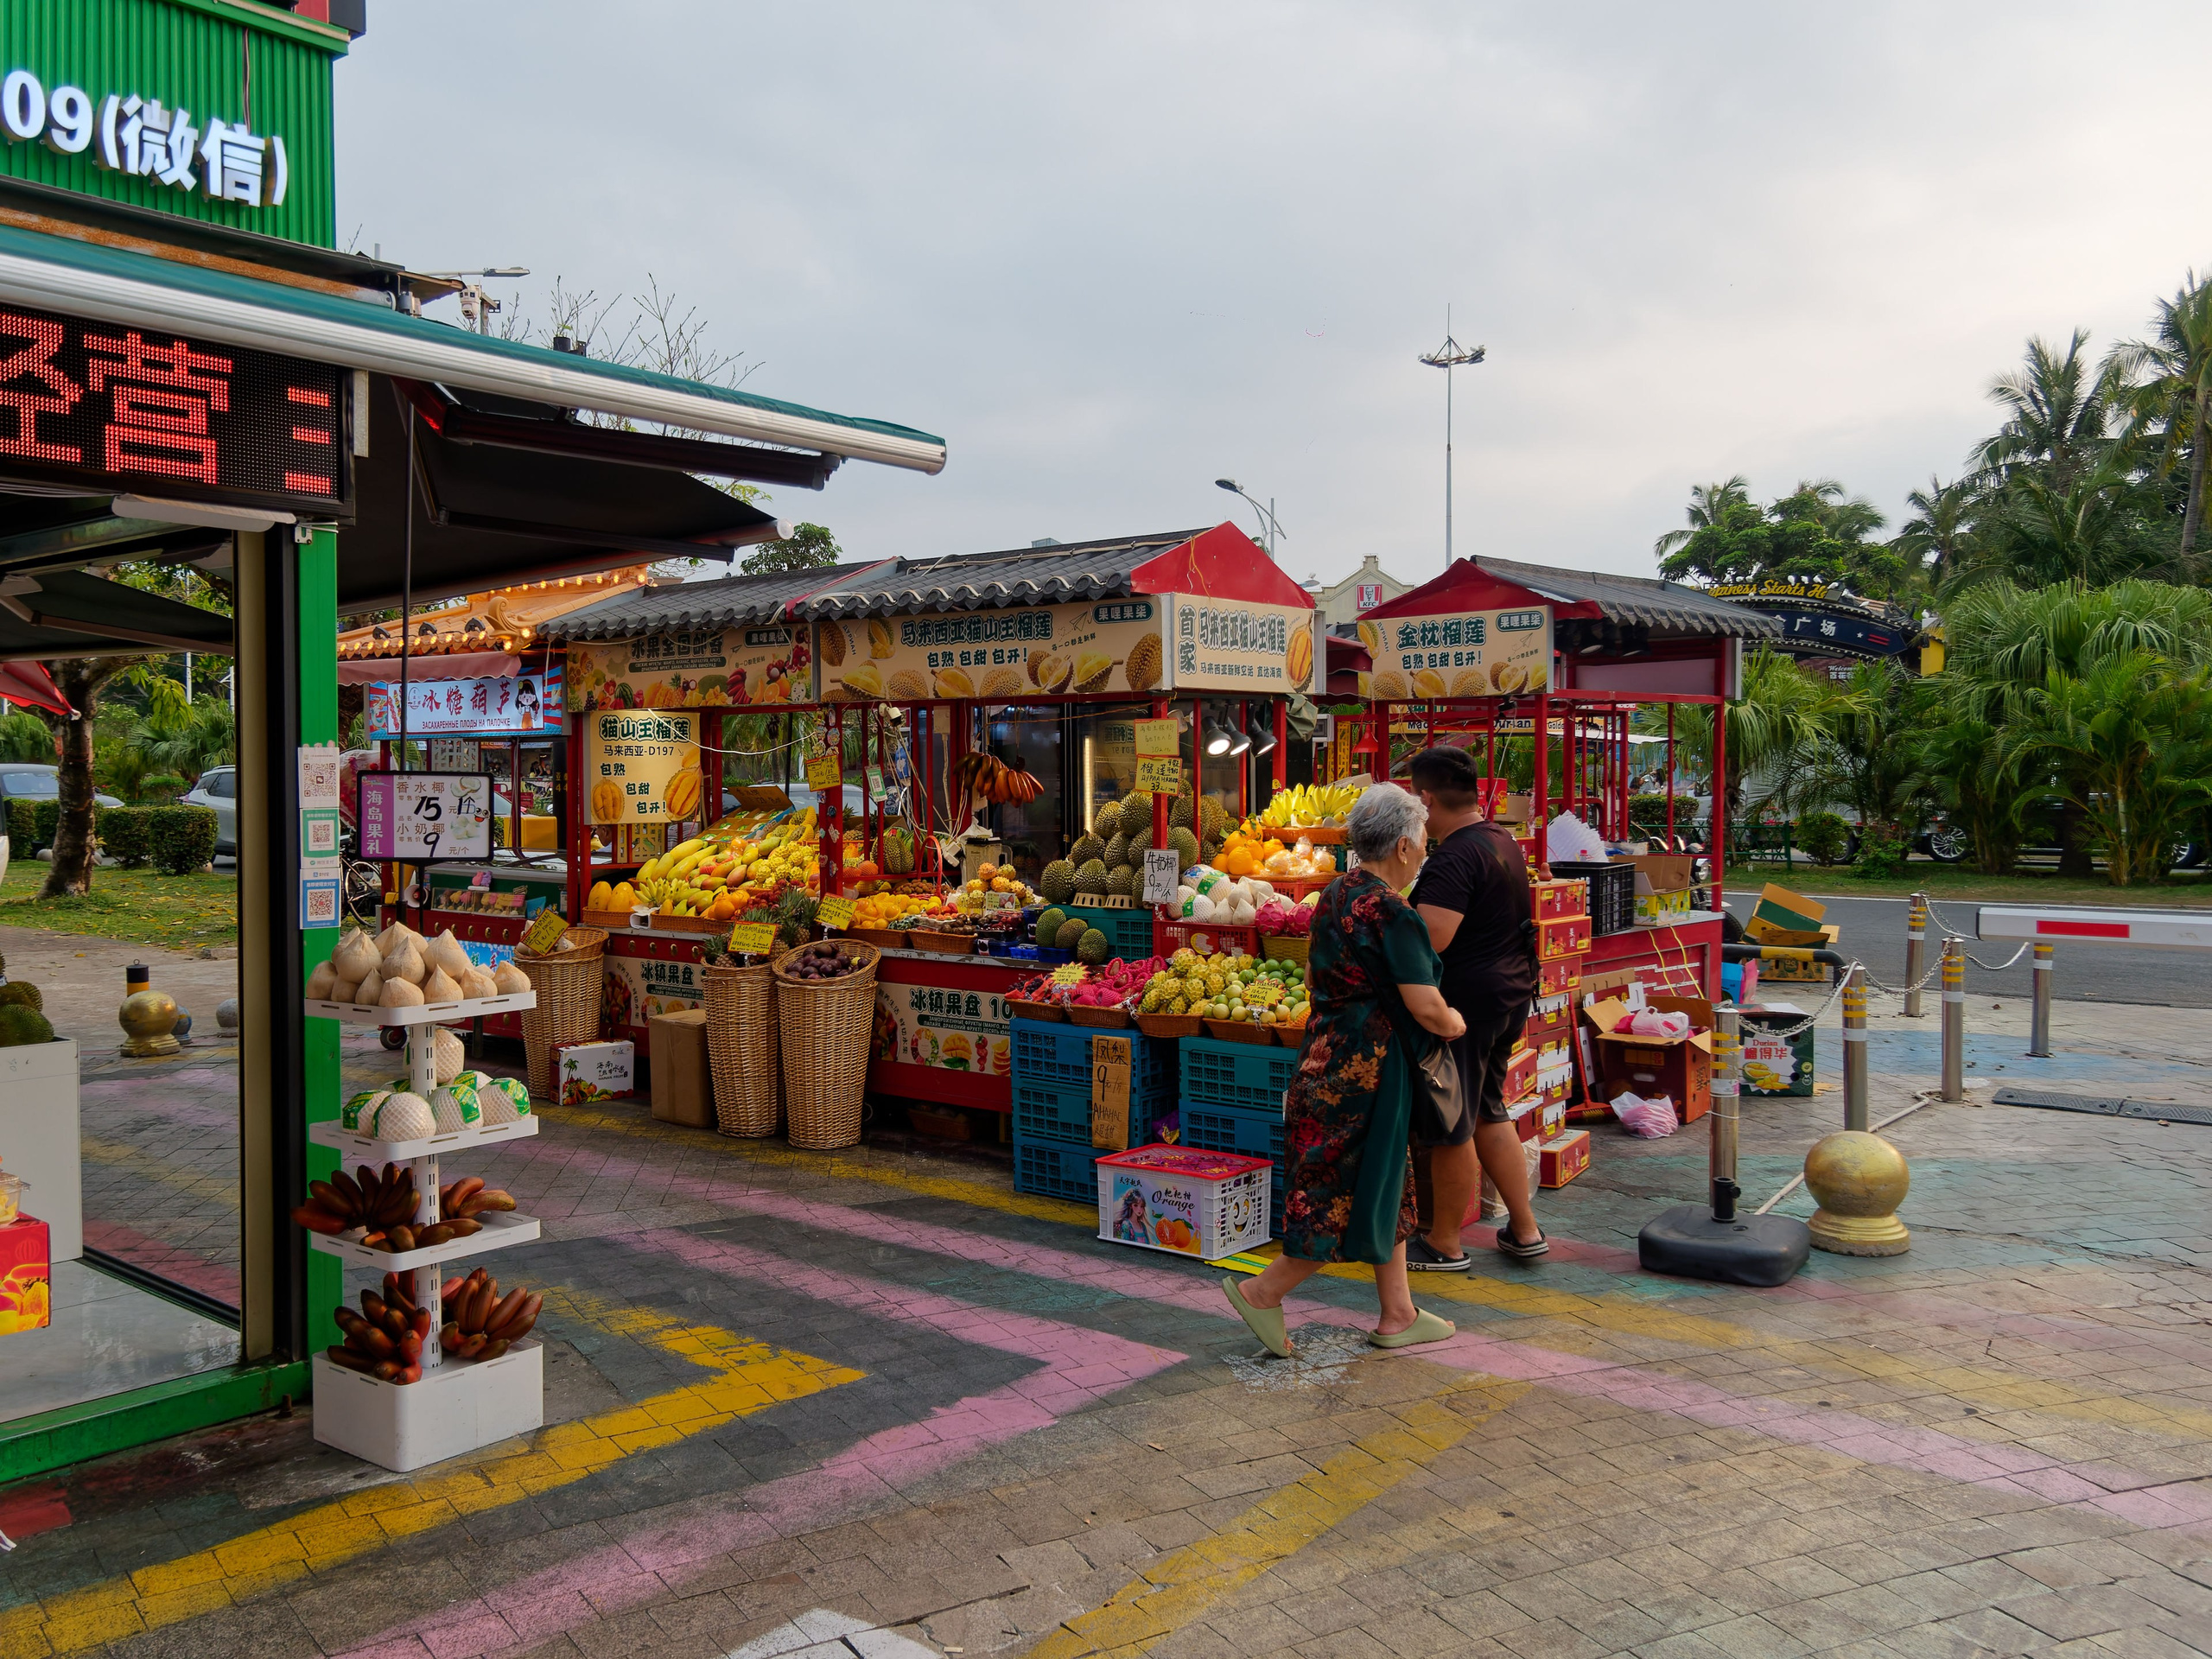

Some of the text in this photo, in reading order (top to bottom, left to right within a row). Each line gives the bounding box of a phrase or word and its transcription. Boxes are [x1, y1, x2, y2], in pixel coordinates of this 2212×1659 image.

[3, 70, 288, 207] 09(微信)
[1759, 579, 1805, 596] Starts
[900, 611, 1053, 646] 马来西亚猫山王榴莲
[1178, 604, 1197, 675] 首家
[1198, 607, 1287, 657] 马来西亚猫山王榴莲
[1376, 621, 1390, 652] ДУРИАН
[1396, 617, 1487, 652] 金枕榴莲
[842, 624, 857, 657] ДУРИАН
[926, 651, 955, 668] 包熟
[959, 649, 987, 666] 包甜
[1402, 654, 1423, 671] 包熟
[1427, 652, 1450, 669] 包甜
[1199, 662, 1282, 679] 马来西亚新鲜空运 直达海南
[422, 681, 512, 716] 冰糖葫芦
[422, 720, 459, 730] ЗАСАХАРЕННЫЕ
[460, 720, 478, 728] ПЛОДЫ
[486, 717, 511, 728] ПАЛОЧКЕ
[599, 715, 691, 743] 猫山王榴莲
[1548, 720, 1565, 729] Golde
[603, 744, 675, 757] 马来西亚-D197
[600, 762, 626, 777] 包熟
[396, 781, 445, 794] 香水椰
[626, 783, 650, 796] 包甜
[413, 796, 442, 822] 15
[366, 790, 384, 855] 海岛果礼
[396, 823, 445, 835] 小奶椰
[423, 831, 441, 858] 9
[448, 846, 470, 855] 元/个
[1146, 851, 1177, 874] 牛奶椰
[640, 960, 694, 987] 冰镇果盘
[909, 987, 982, 1019] 冰镇果盘
[1745, 1047, 1788, 1059] 榴得华
[1094, 1123, 1116, 1139] 超甜
[1152, 1190, 1196, 1212] Orange
